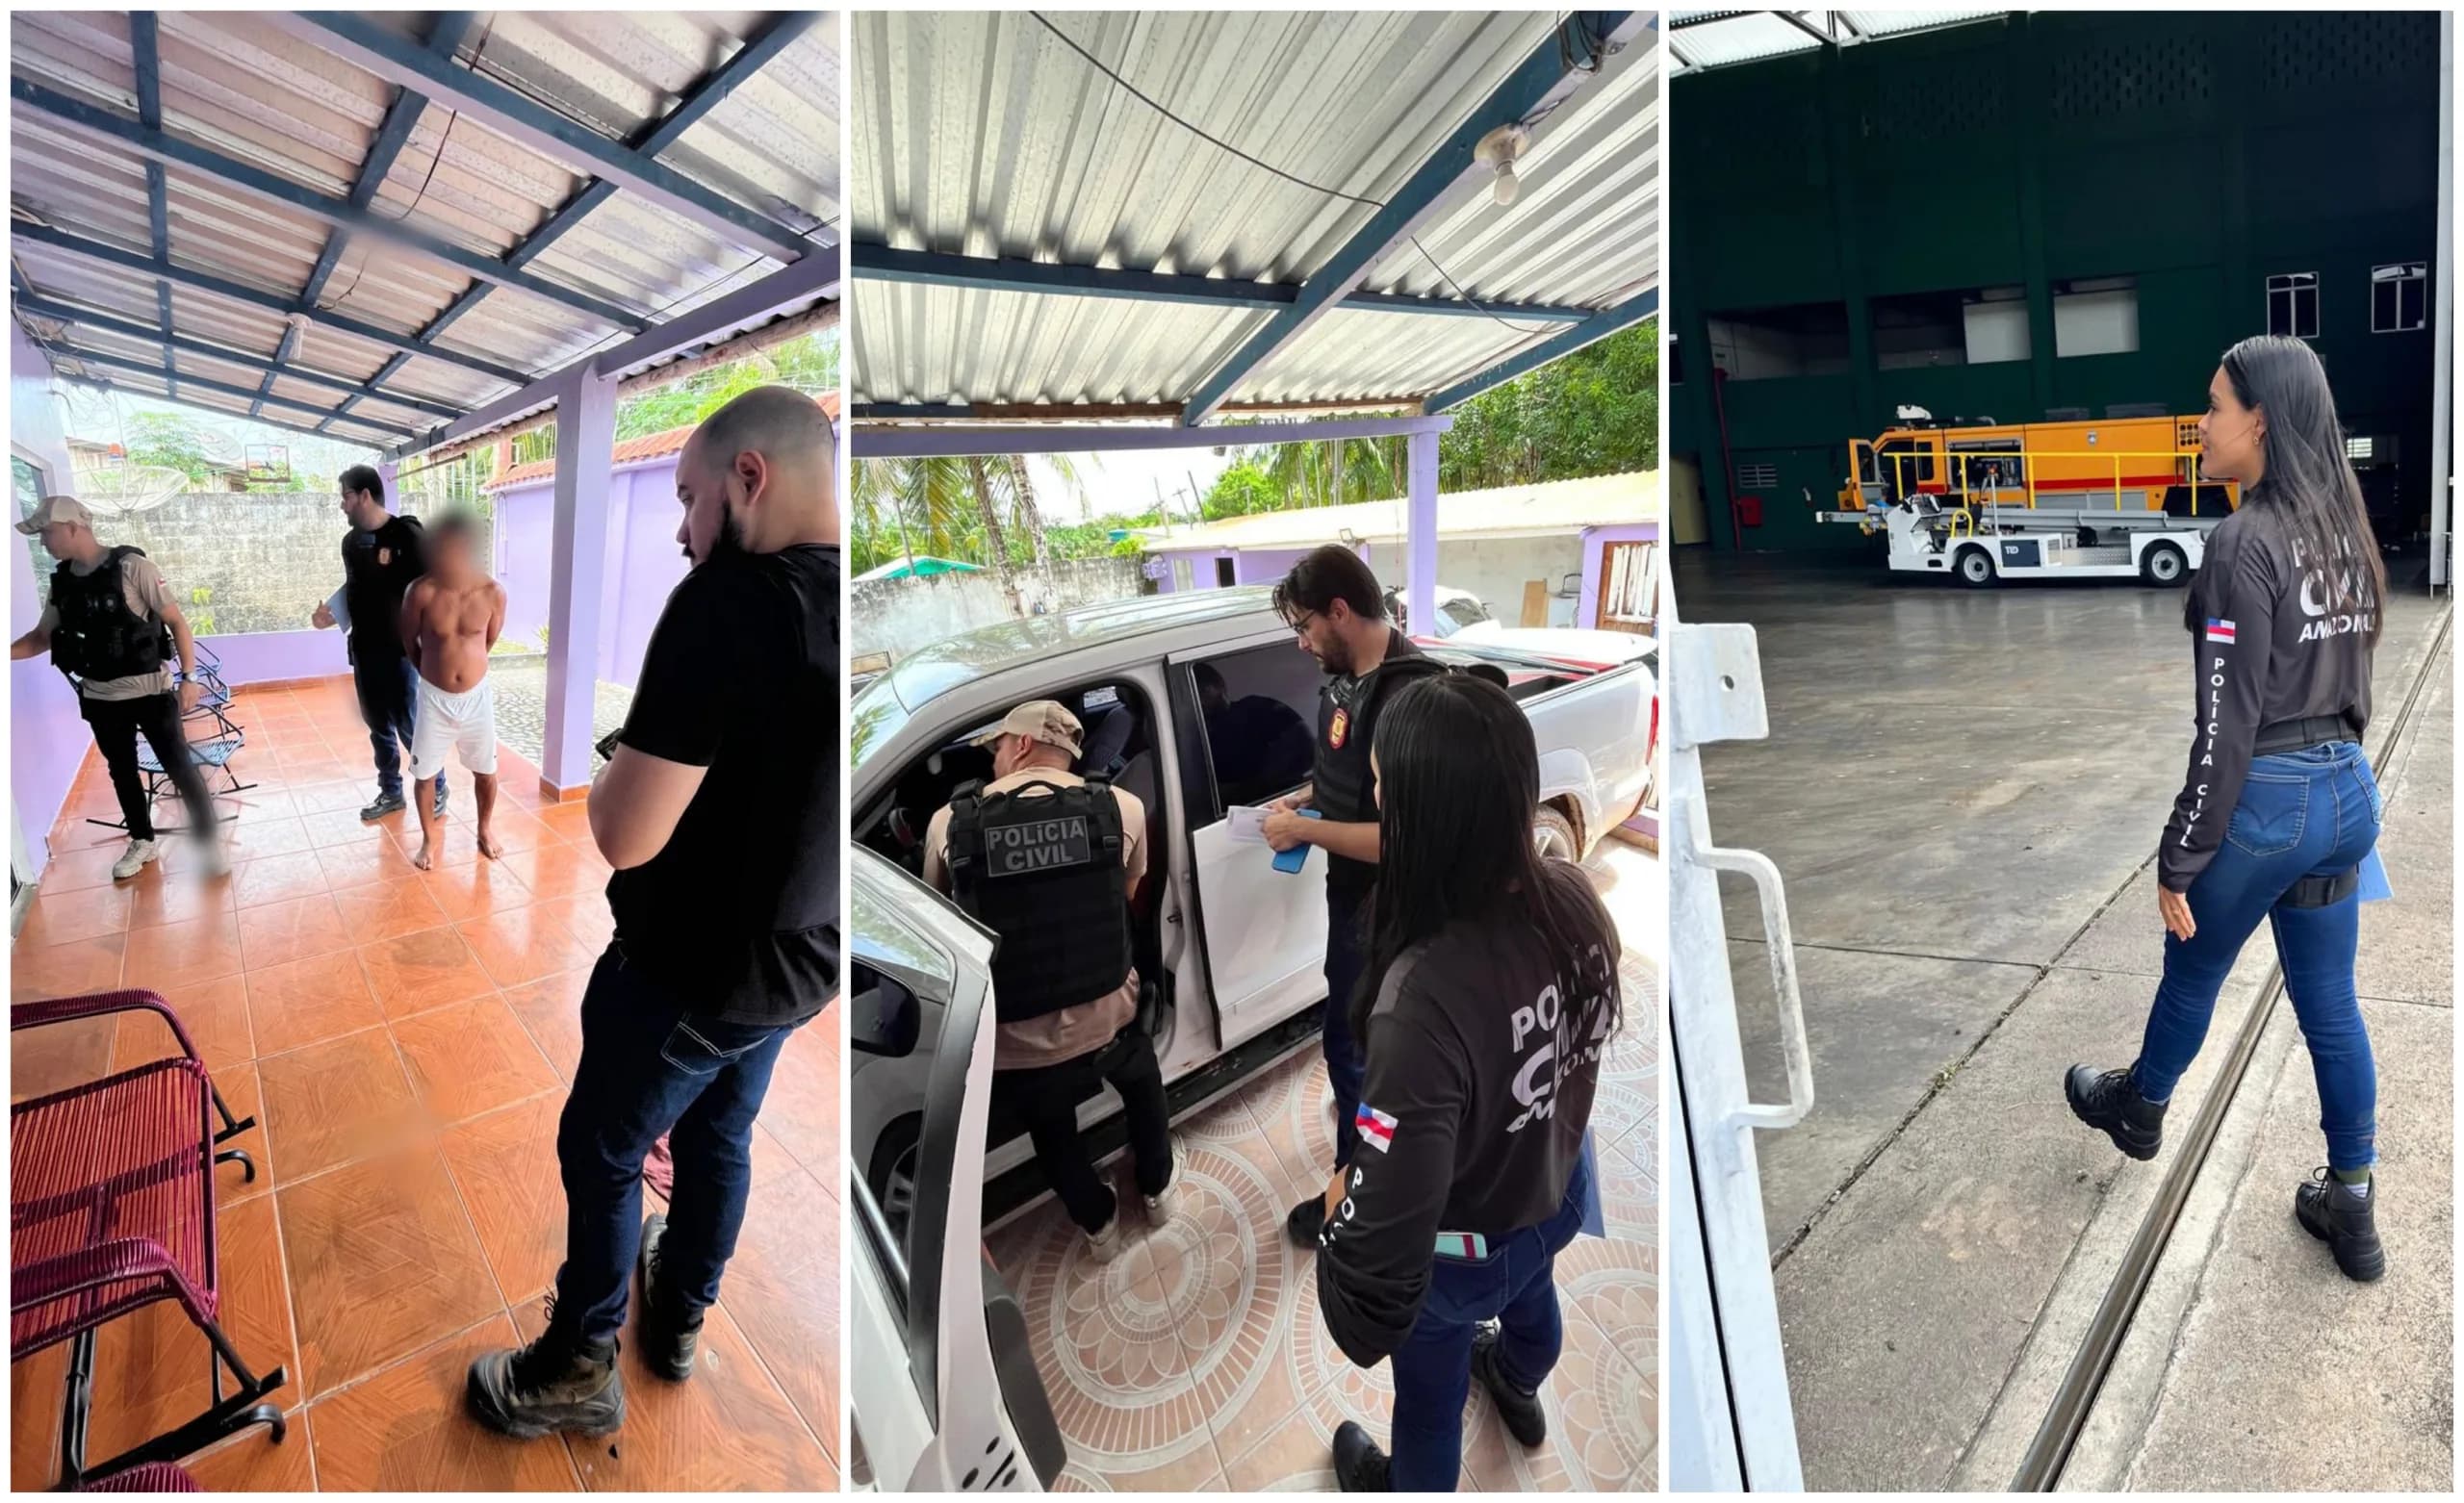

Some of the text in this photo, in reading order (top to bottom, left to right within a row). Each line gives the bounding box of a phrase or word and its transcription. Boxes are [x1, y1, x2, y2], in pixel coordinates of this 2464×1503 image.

[2180, 657, 2225, 847] POLÍCIA CIVIL
[1005, 843, 1074, 871] CIVIL
